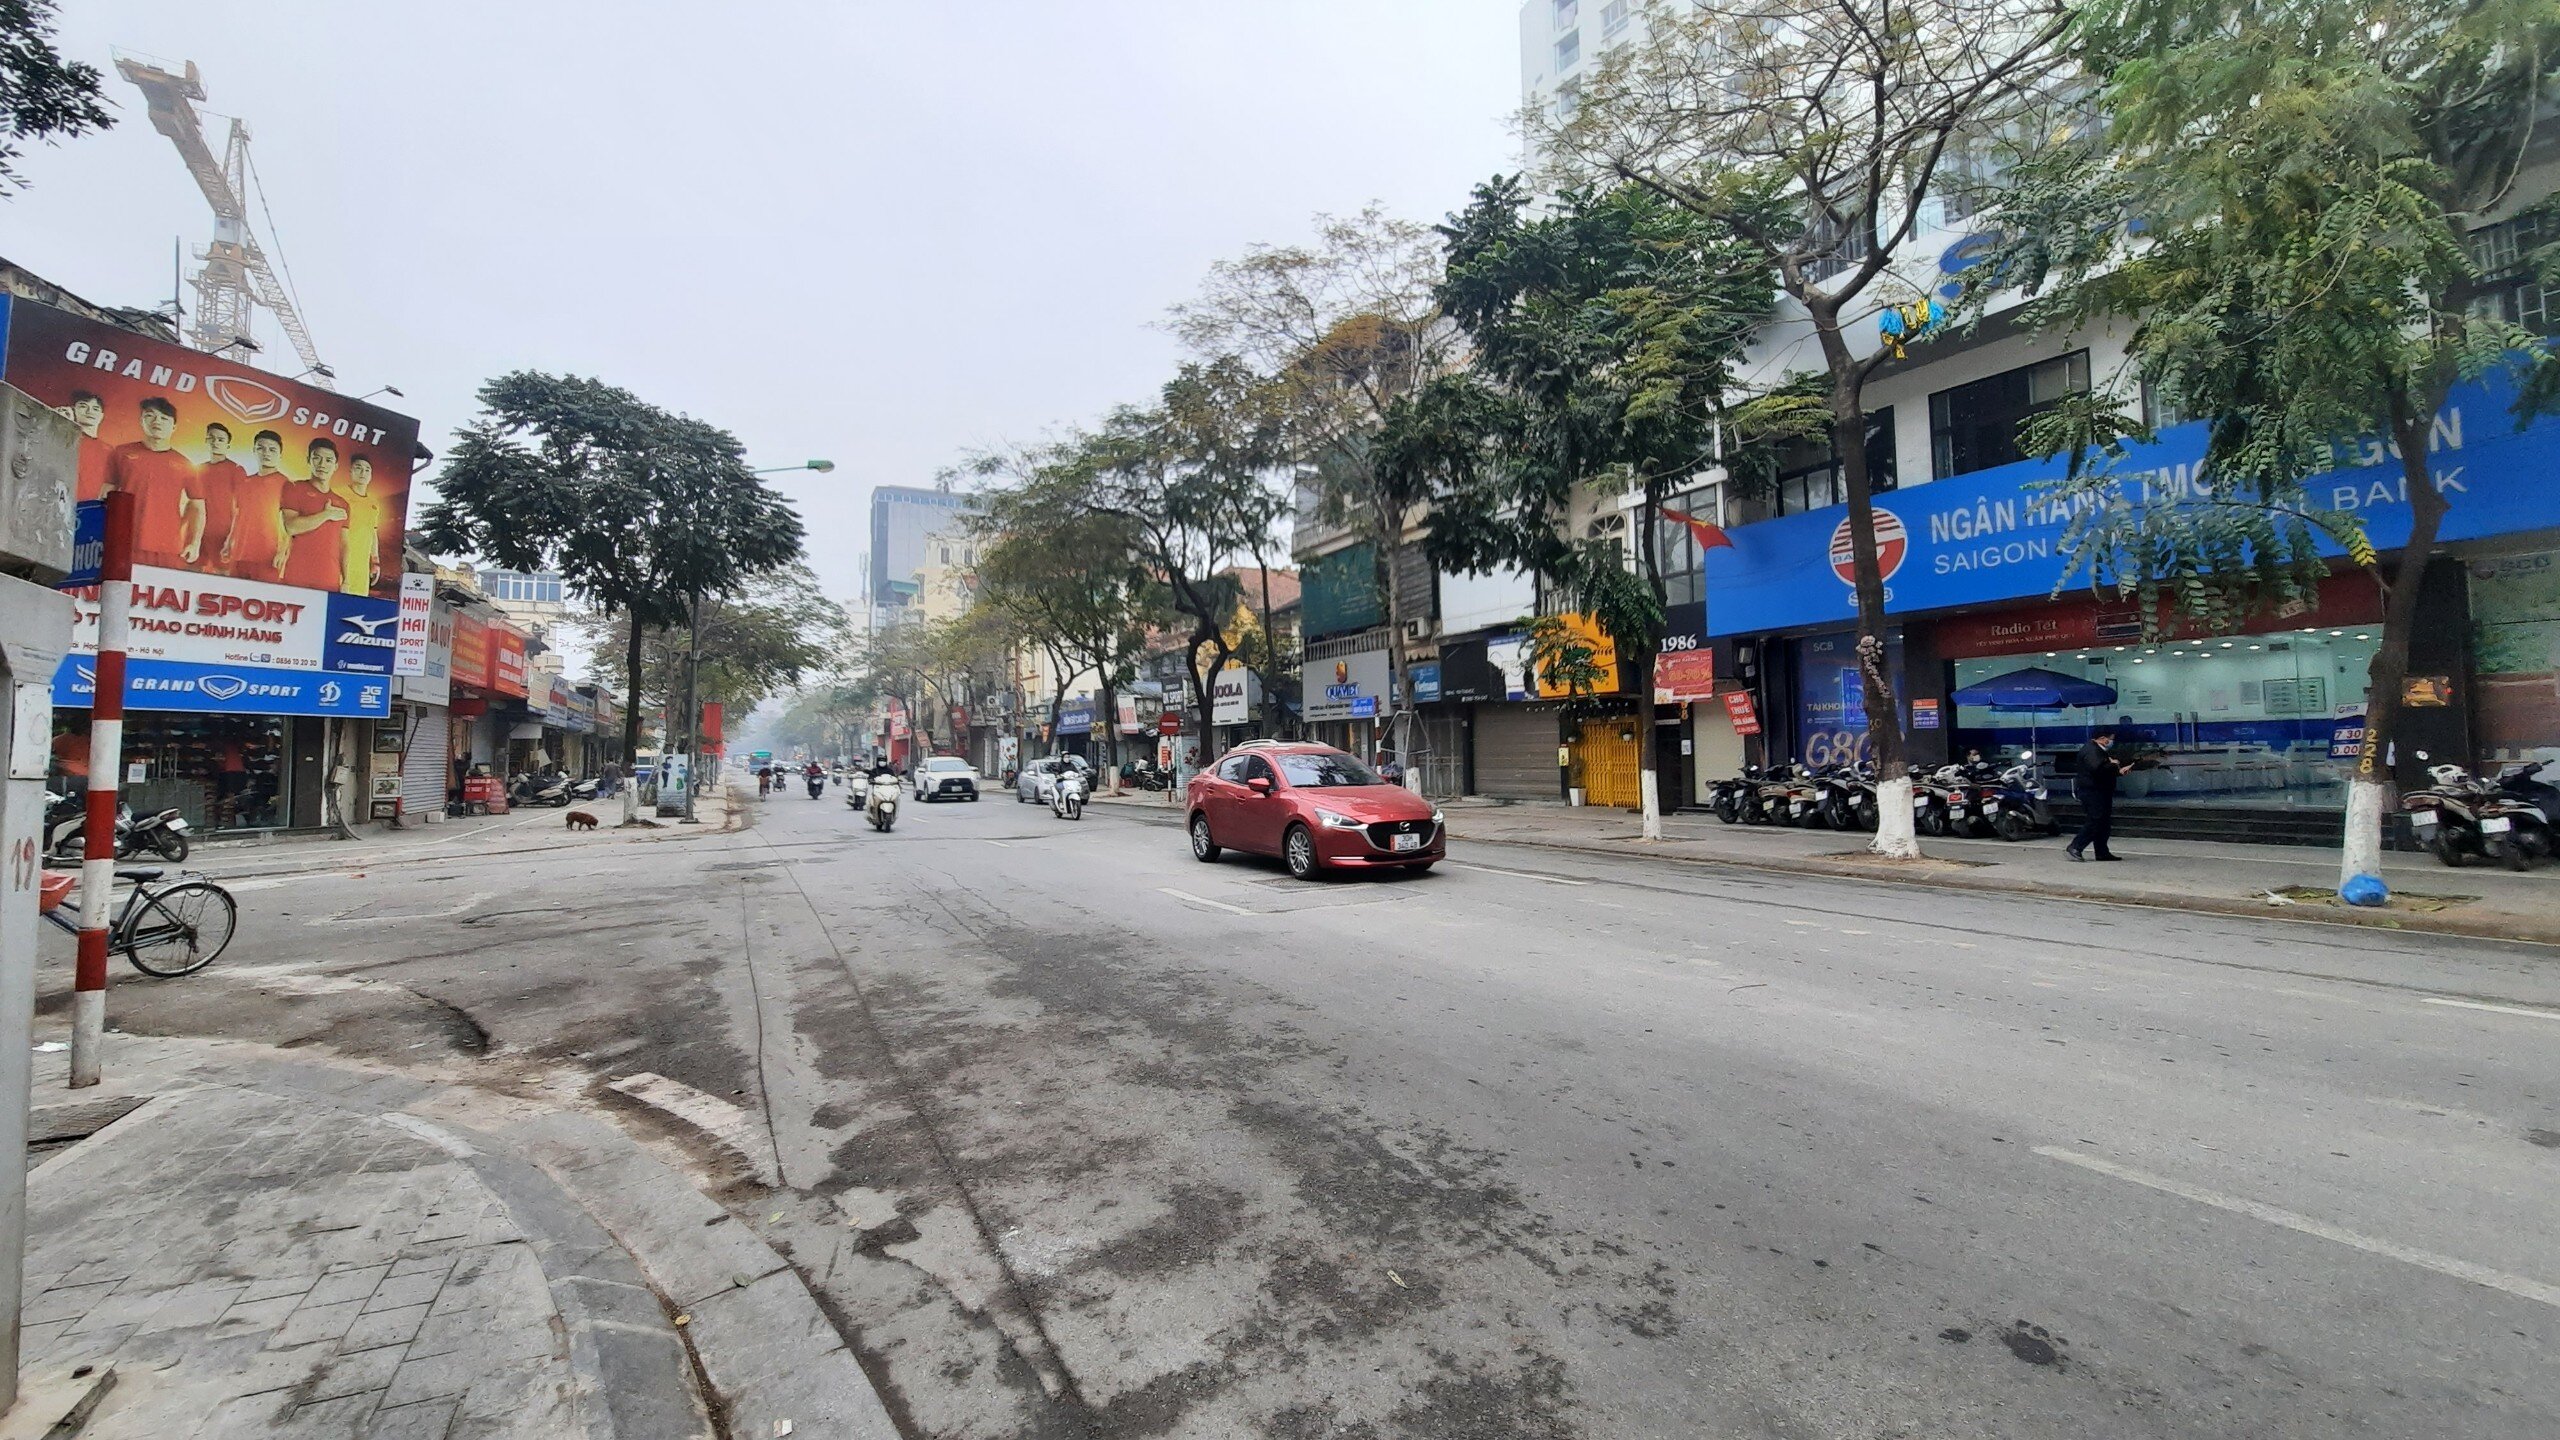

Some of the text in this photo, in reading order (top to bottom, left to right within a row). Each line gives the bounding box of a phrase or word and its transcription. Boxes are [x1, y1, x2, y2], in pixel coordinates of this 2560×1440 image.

[65, 341, 386, 446] GRAND SPORT
[1931, 496, 2015, 545] NGÂN
[2135, 457, 2215, 505] TMC
[1832, 553, 1855, 564] BA
[1934, 538, 2047, 575] SAIGON
[130, 584, 190, 613] HAI
[195, 592, 305, 625] SPORT
[402, 596, 430, 612] MINH
[128, 616, 182, 635] THAO
[185, 622, 235, 639] CHÍNH
[401, 617, 426, 632] HAI
[1991, 622, 2031, 637] Radio
[399, 637, 425, 647] SPORT
[1661, 633, 1698, 652] 1986
[1812, 640, 1834, 652] SCB
[224, 652, 249, 662] Hotline
[403, 657, 418, 665] 163
[132, 677, 196, 693] GRAND
[248, 684, 302, 698] SPORT
[1214, 682, 1244, 699] JOOLA
[2359, 728, 2379, 774] 228
